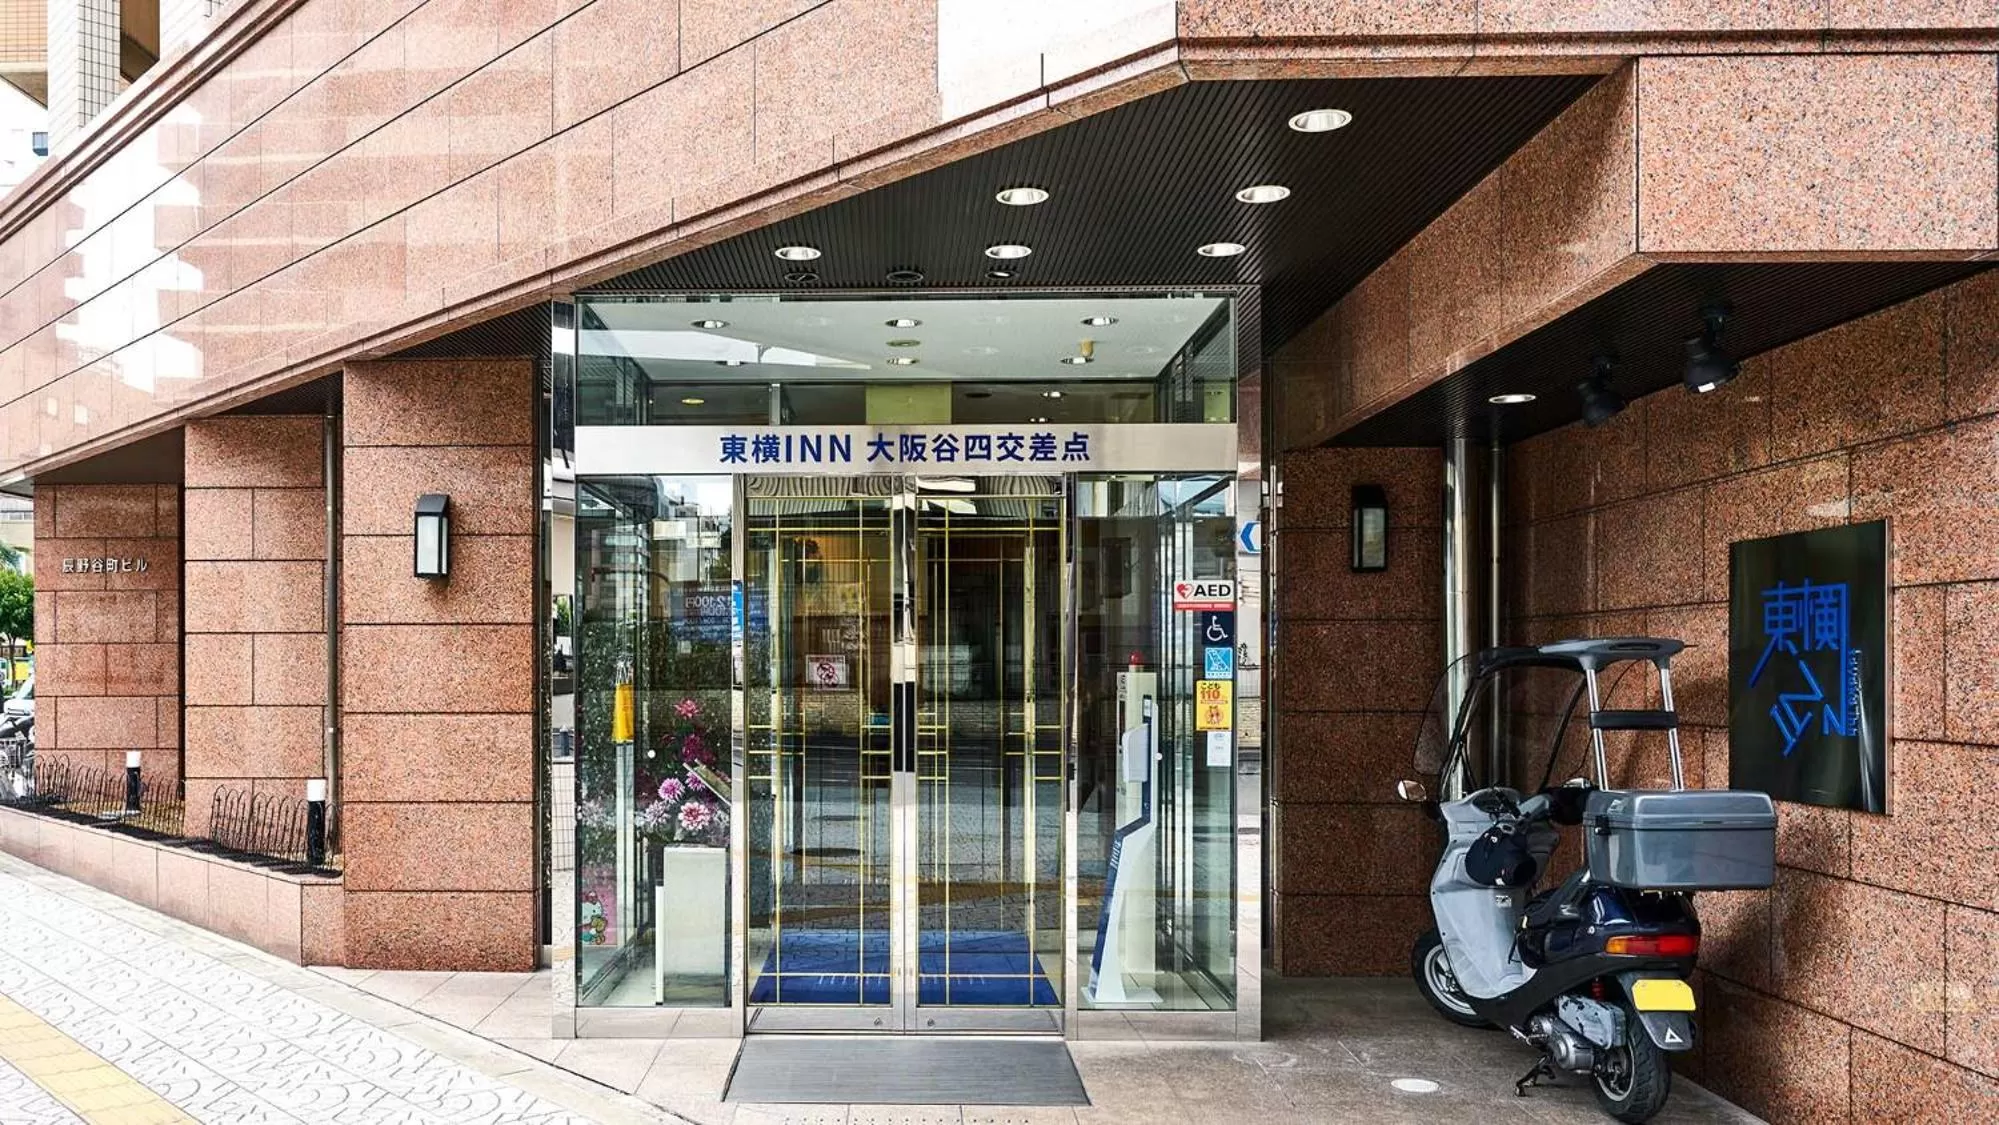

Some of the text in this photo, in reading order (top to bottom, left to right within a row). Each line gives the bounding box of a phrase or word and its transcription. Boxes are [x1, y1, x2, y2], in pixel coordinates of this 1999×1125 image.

[719, 432, 1090, 464] 東横INN 大阪谷四交差点
[62, 558, 148, 573] 辰野谷町ビル
[1193, 584, 1231, 597] AED
[1200, 690, 1220, 700] 110
